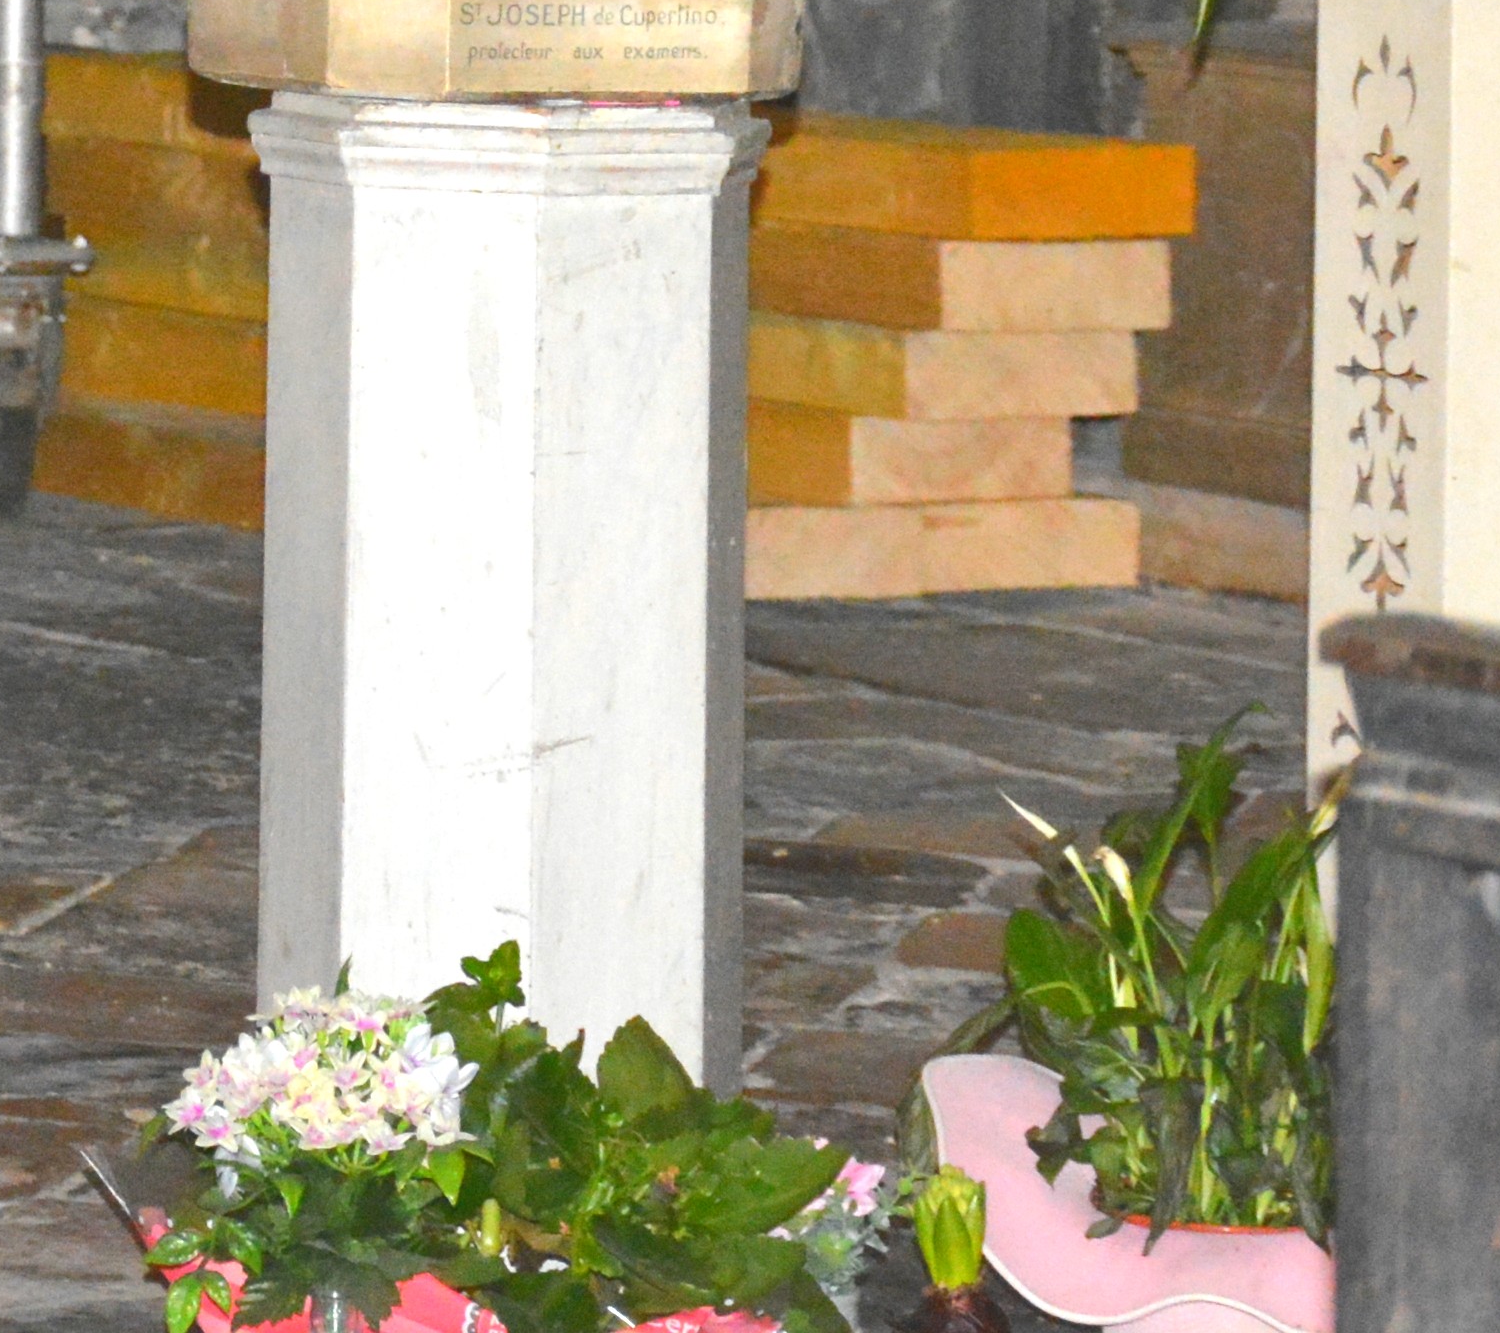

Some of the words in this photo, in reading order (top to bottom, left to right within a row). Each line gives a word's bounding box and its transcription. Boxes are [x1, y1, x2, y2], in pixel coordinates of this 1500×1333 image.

[487, 3, 586, 27] JOSEPH
[593, 8, 615, 26] de
[467, 42, 553, 68] protecteur
[572, 45, 604, 60] aux
